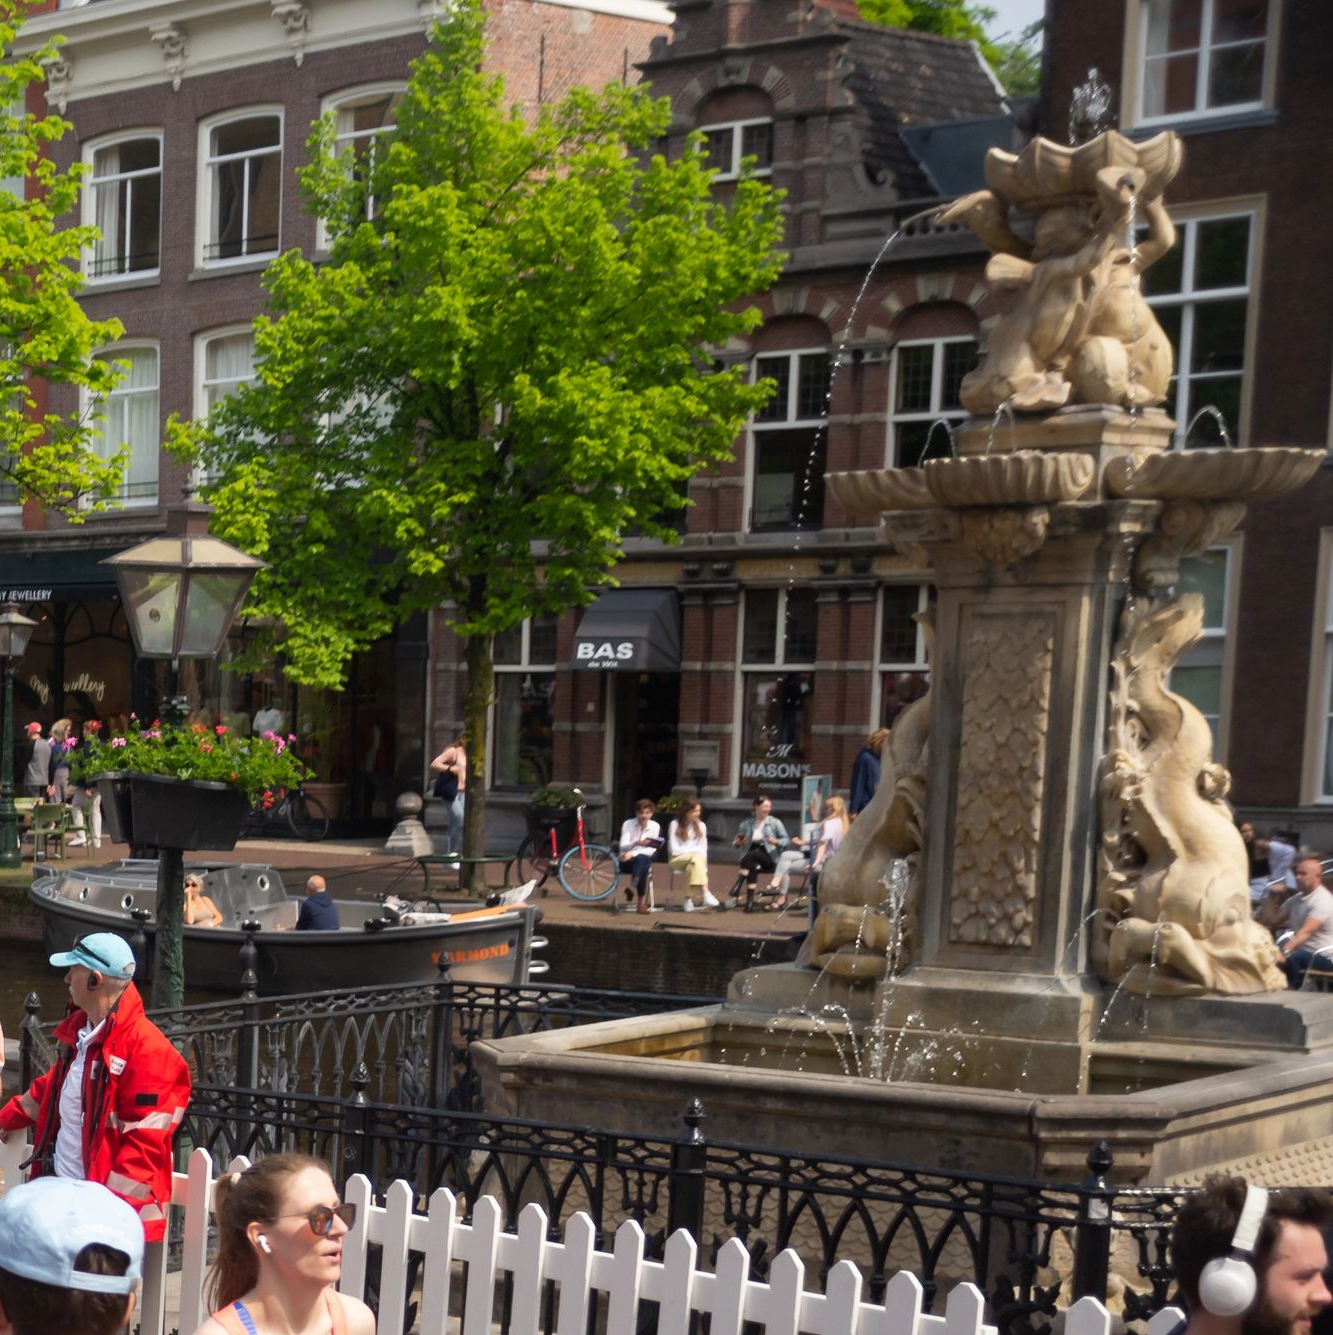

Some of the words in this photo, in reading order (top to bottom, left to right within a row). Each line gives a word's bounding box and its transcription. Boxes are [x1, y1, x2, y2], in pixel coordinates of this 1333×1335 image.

[8, 589, 52, 600] JEWELLERY
[576, 642, 634, 659] BAS
[30, 675, 50, 704] My
[742, 762, 812, 779] MASON'S
